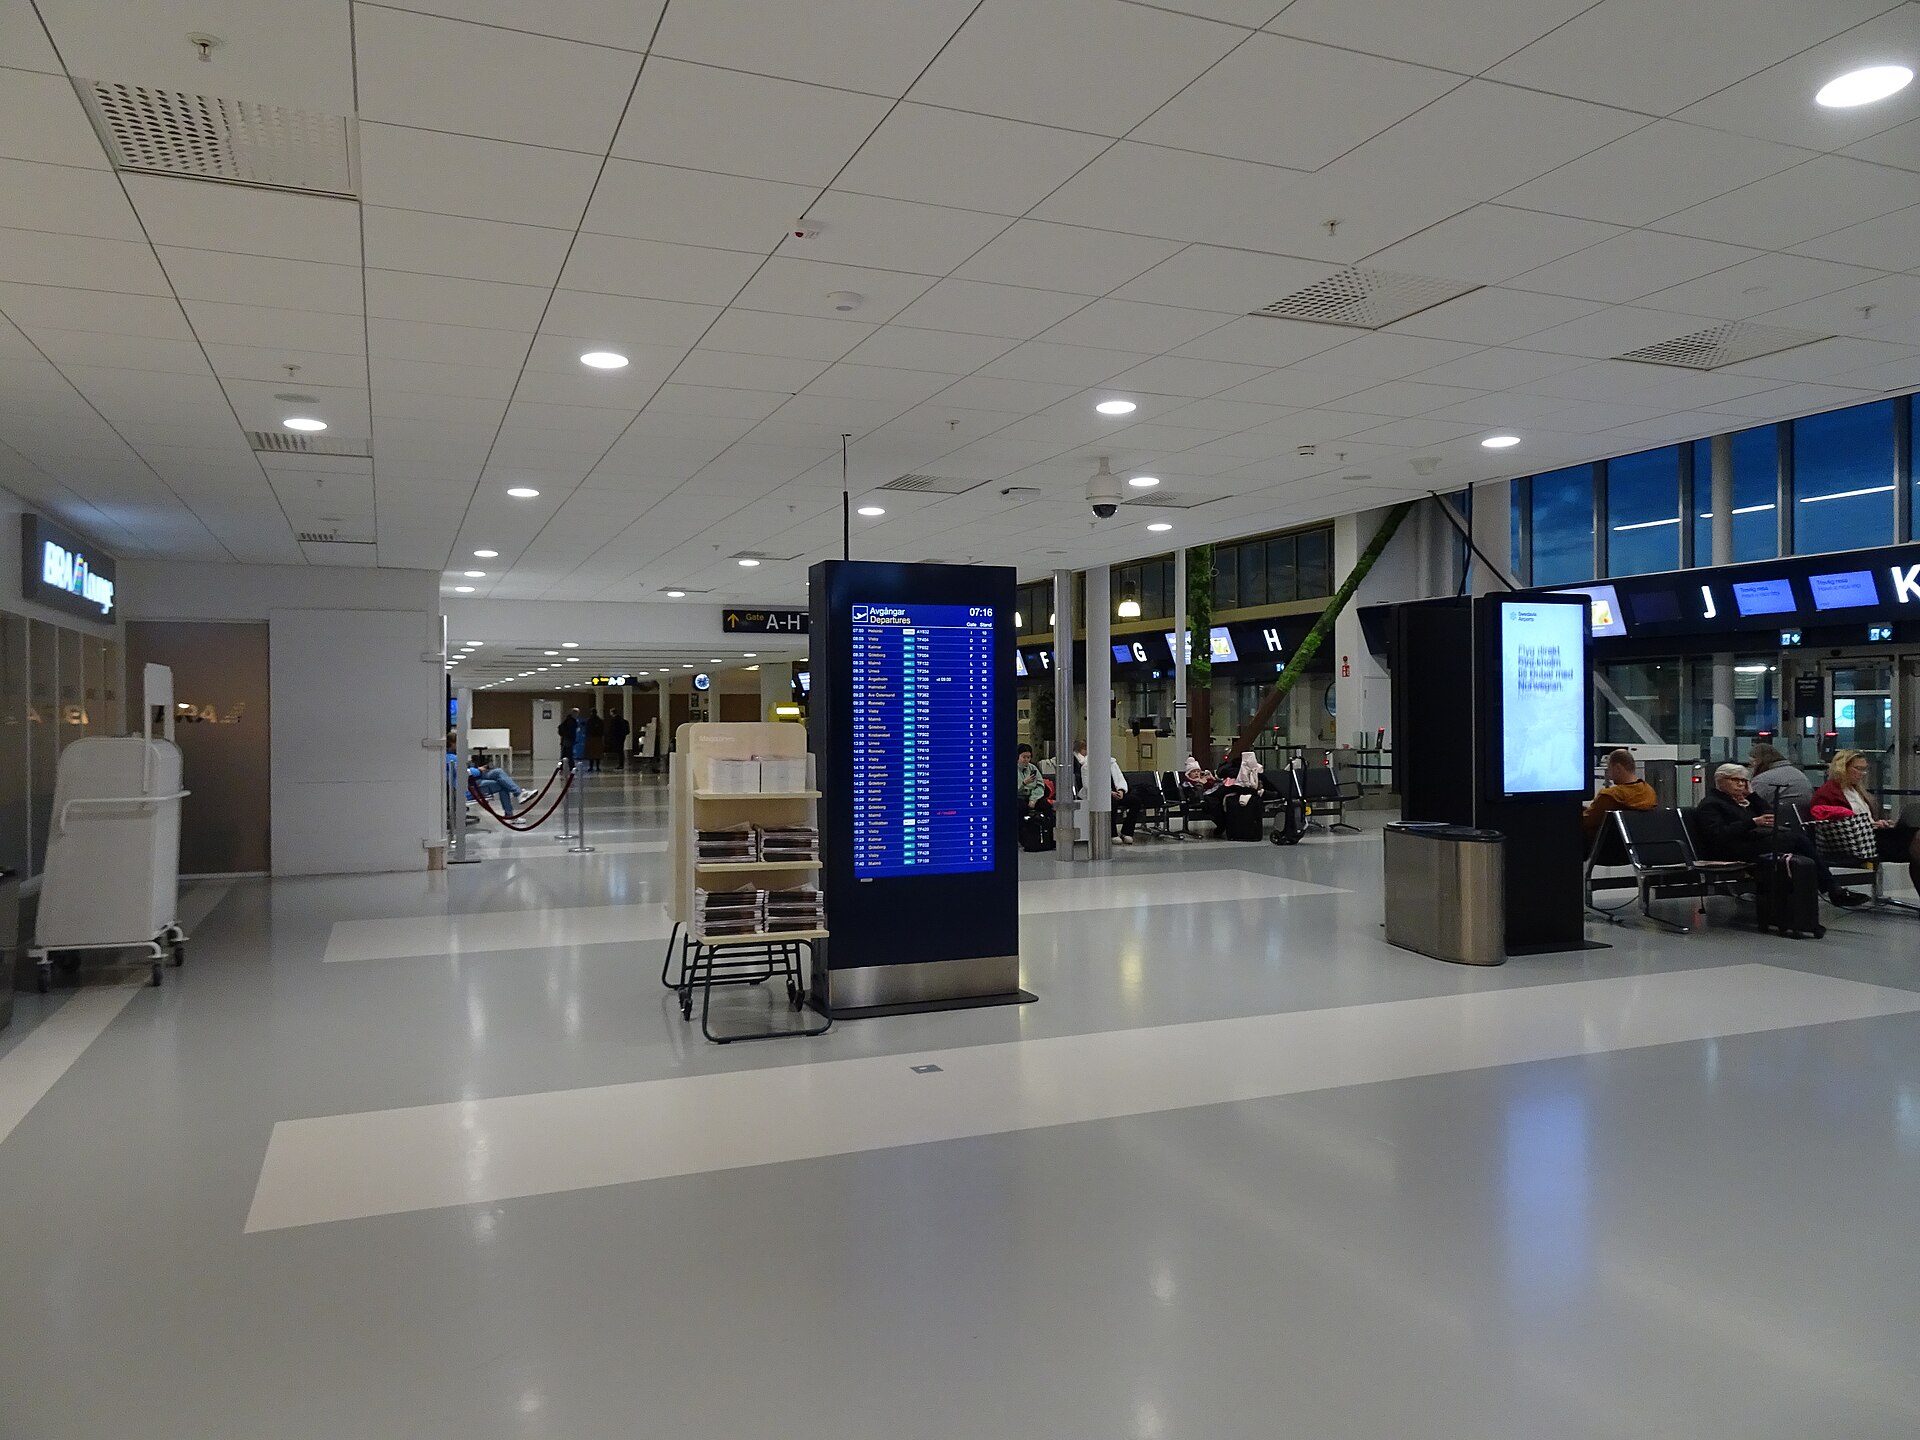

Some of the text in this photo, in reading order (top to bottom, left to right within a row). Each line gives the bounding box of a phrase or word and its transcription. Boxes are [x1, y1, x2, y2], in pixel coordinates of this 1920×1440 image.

[43, 541, 75, 592] BRA
[1890, 564, 1920, 604] K
[1701, 586, 1717, 619] J
[870, 607, 905, 617] Avgångar
[870, 616, 911, 625] Departures
[969, 608, 993, 617] 07:16
[766, 614, 800, 630] A-H
[1263, 628, 1282, 652] H
[1040, 652, 1050, 669] F
[1132, 642, 1148, 662] G
